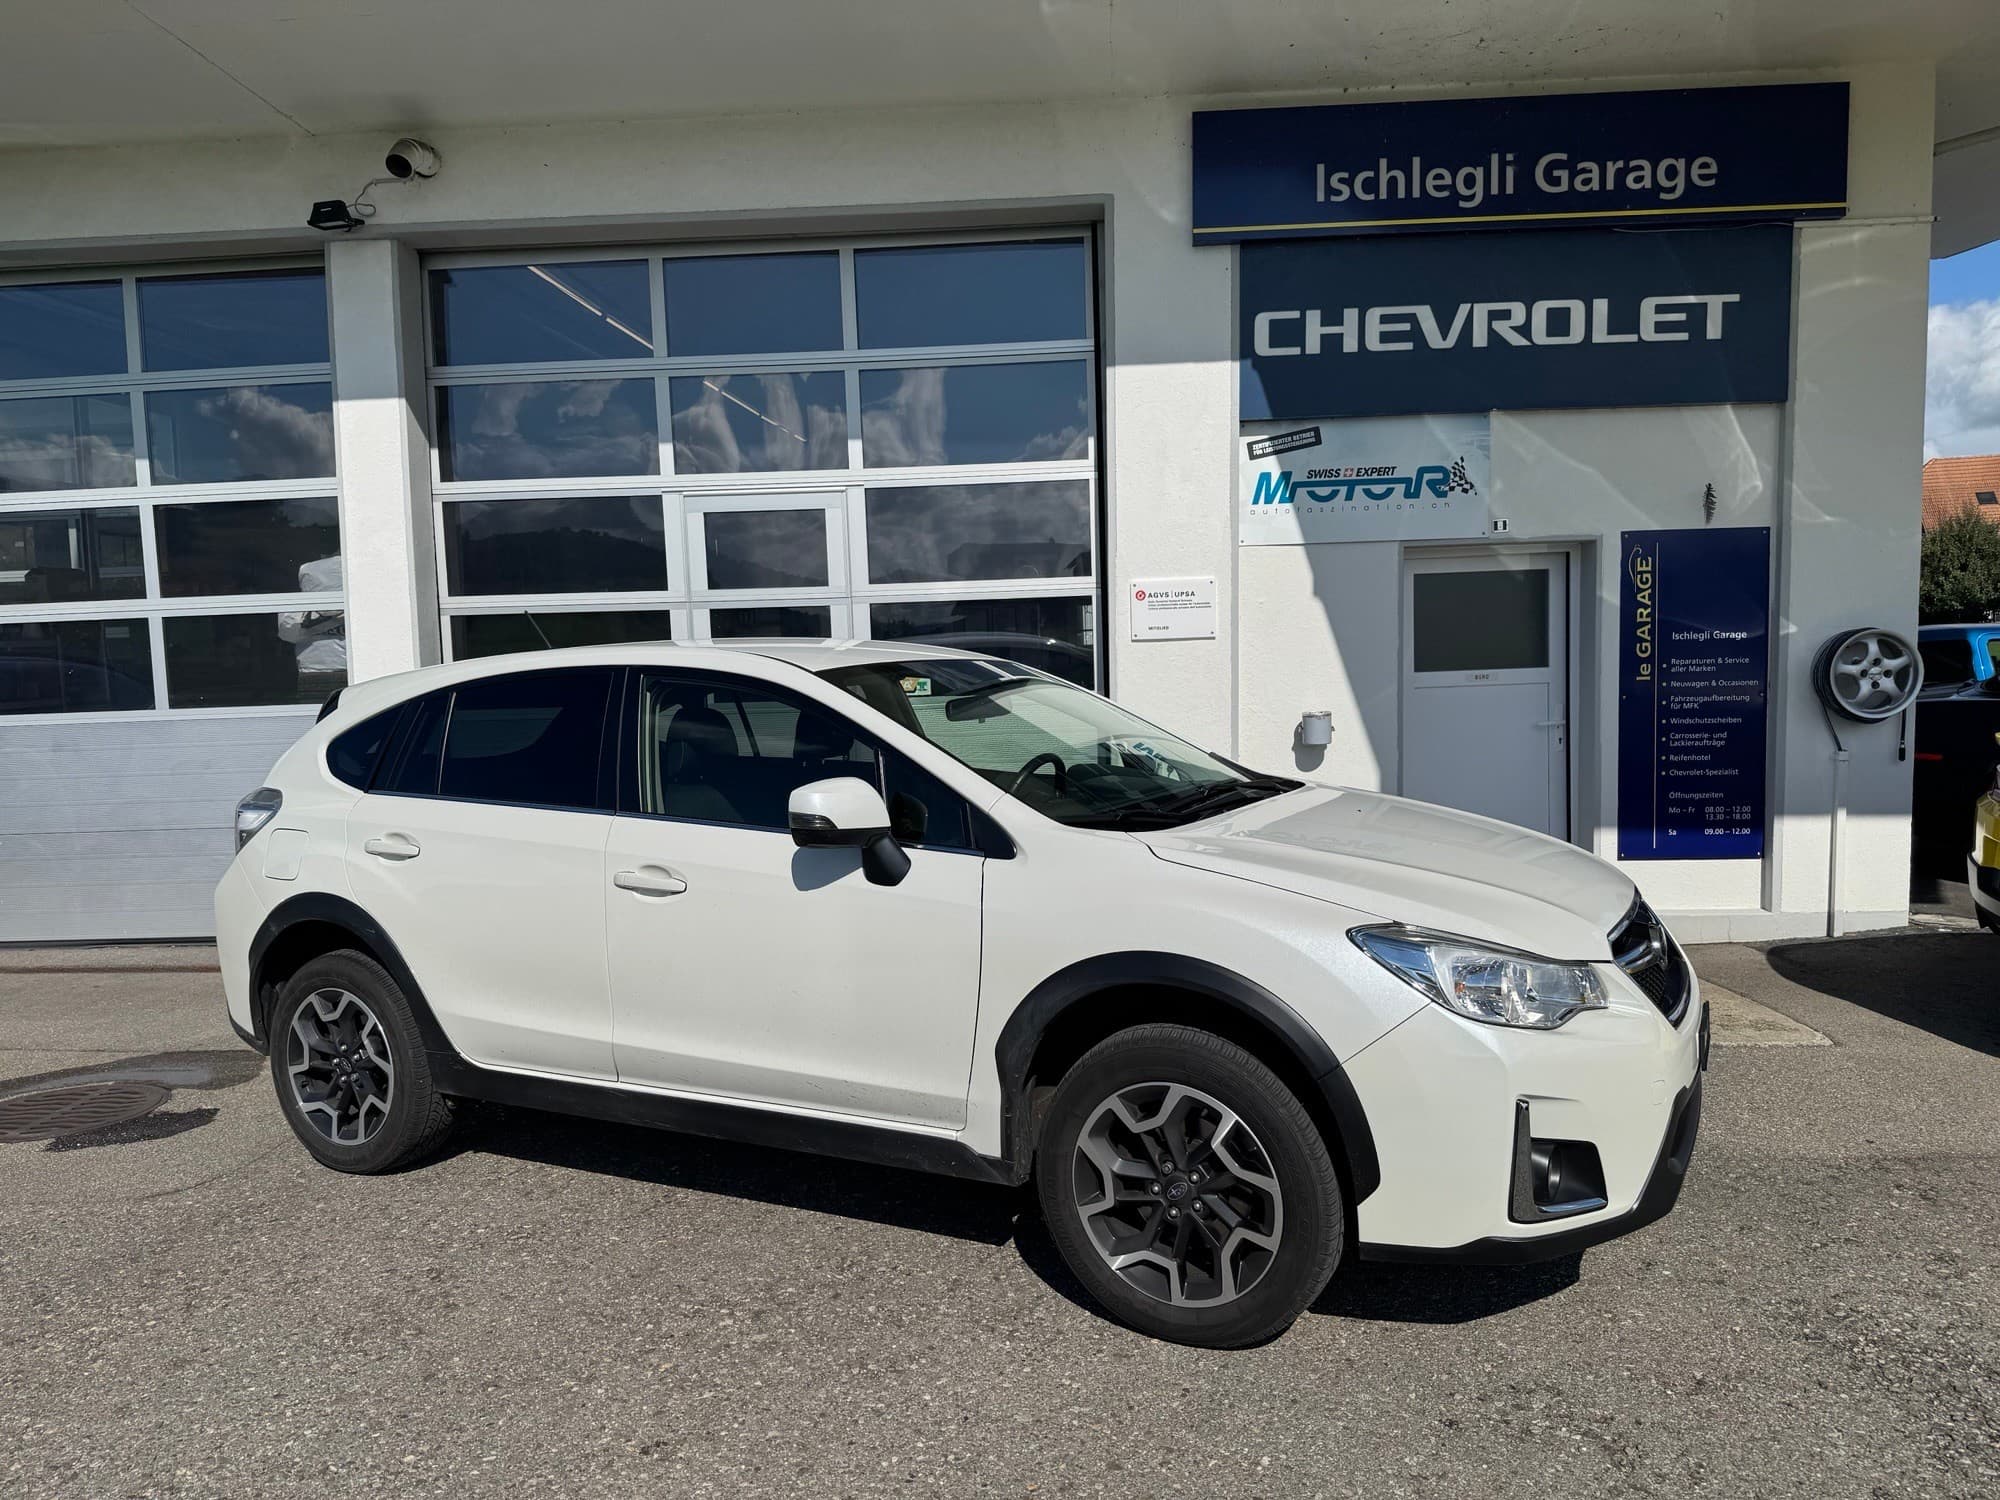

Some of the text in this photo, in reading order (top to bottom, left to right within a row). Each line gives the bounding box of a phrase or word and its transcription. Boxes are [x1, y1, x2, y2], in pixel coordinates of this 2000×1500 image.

[1315, 150, 1719, 208] Ischlegli Garage
[1253, 293, 1741, 357] CHEVROLET
[1307, 466, 1397, 479] SWISS EXPERT
[1636, 556, 1652, 681] le GARAGE
[1672, 630, 1748, 642] Ischlegli Garage
[1671, 658, 1715, 666] Reparaturen
[1670, 680, 1709, 689] Neuwagen
[1670, 694, 1750, 703] Fahrzeugaufbereitung
[1670, 702, 1681, 710] für
[1670, 716, 1742, 724] Windschutzscheiben
[1669, 739, 1726, 747] Lackieraufträge
[1669, 768, 1739, 776] Chevrolet-Spezialist
[1668, 791, 1724, 800] Öffnungszeiten
[1668, 828, 1677, 836] Sa
[1732, 827, 1751, 835] 12.00
